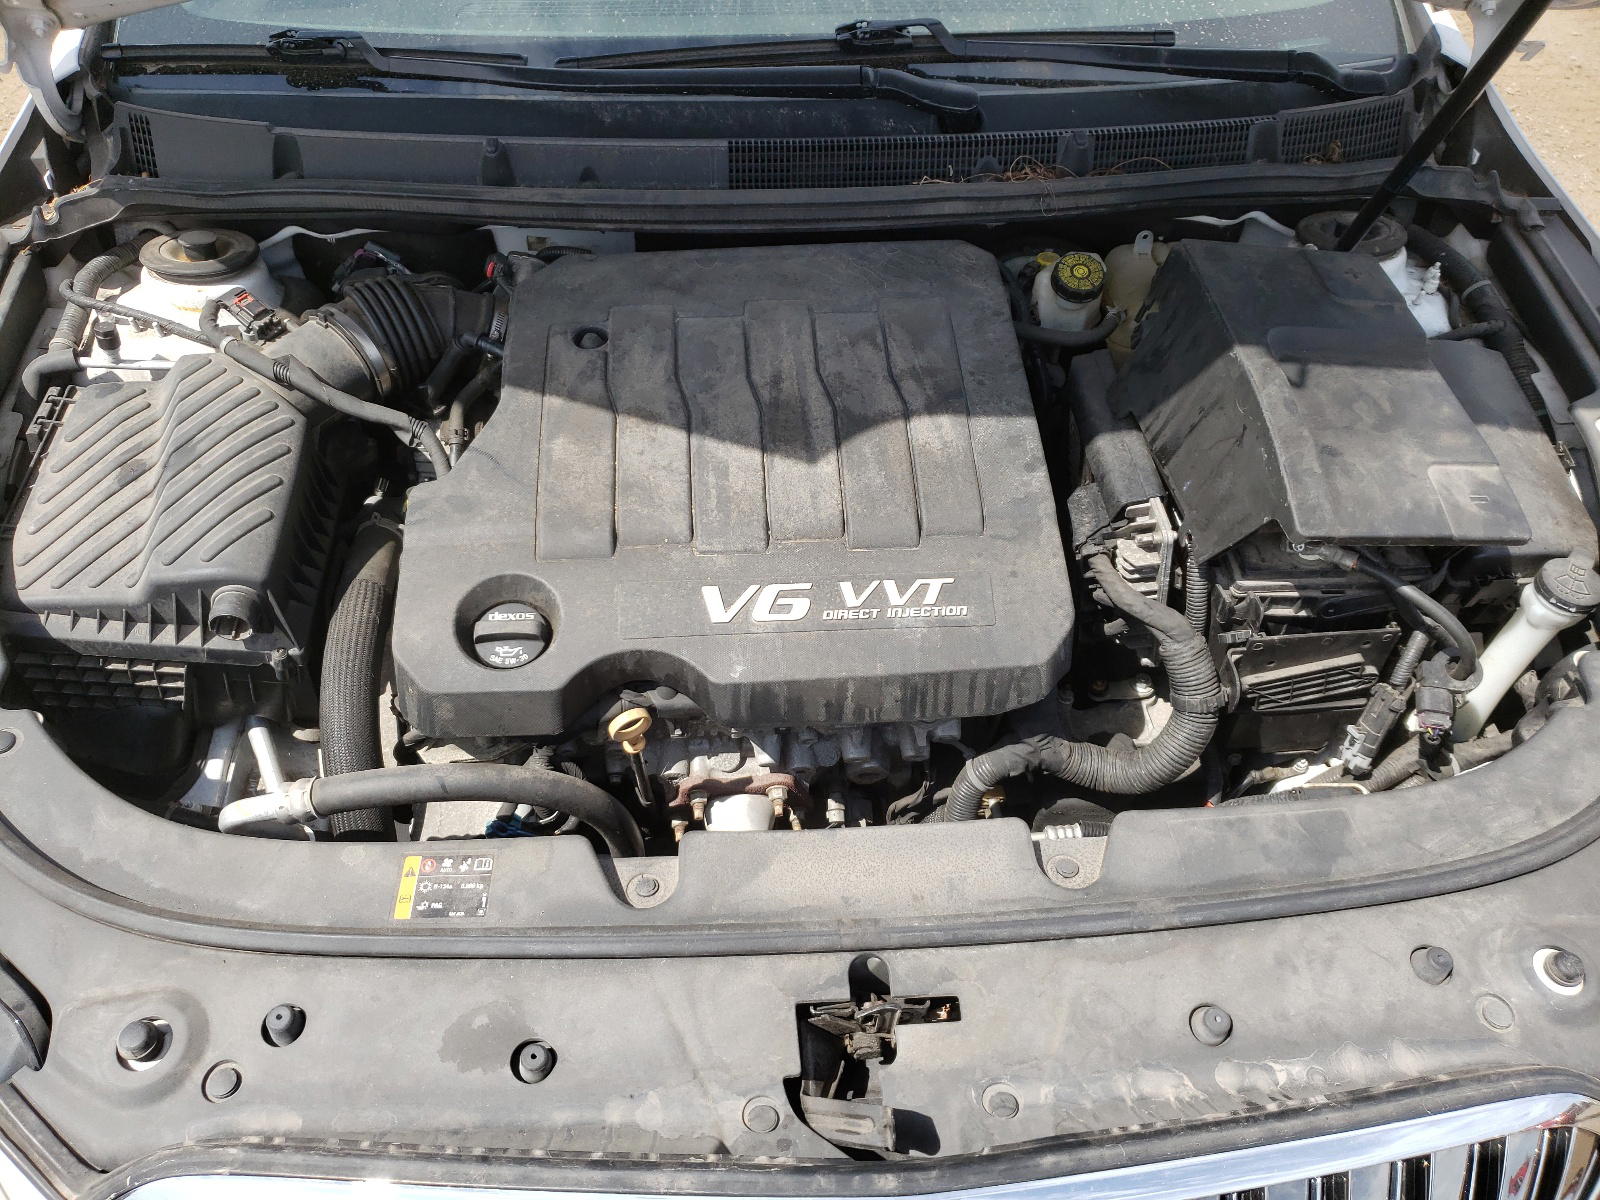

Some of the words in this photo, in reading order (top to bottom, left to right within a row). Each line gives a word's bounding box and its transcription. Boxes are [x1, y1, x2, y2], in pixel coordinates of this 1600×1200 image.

[701, 583, 813, 623] V6
[839, 578, 955, 607] VVT
[488, 612, 536, 620] dexos
[822, 609, 880, 620] DIRECT
[887, 605, 968, 618] INJECTION
[489, 654, 503, 665] SAE
[505, 654, 529, 665] 5W-30
